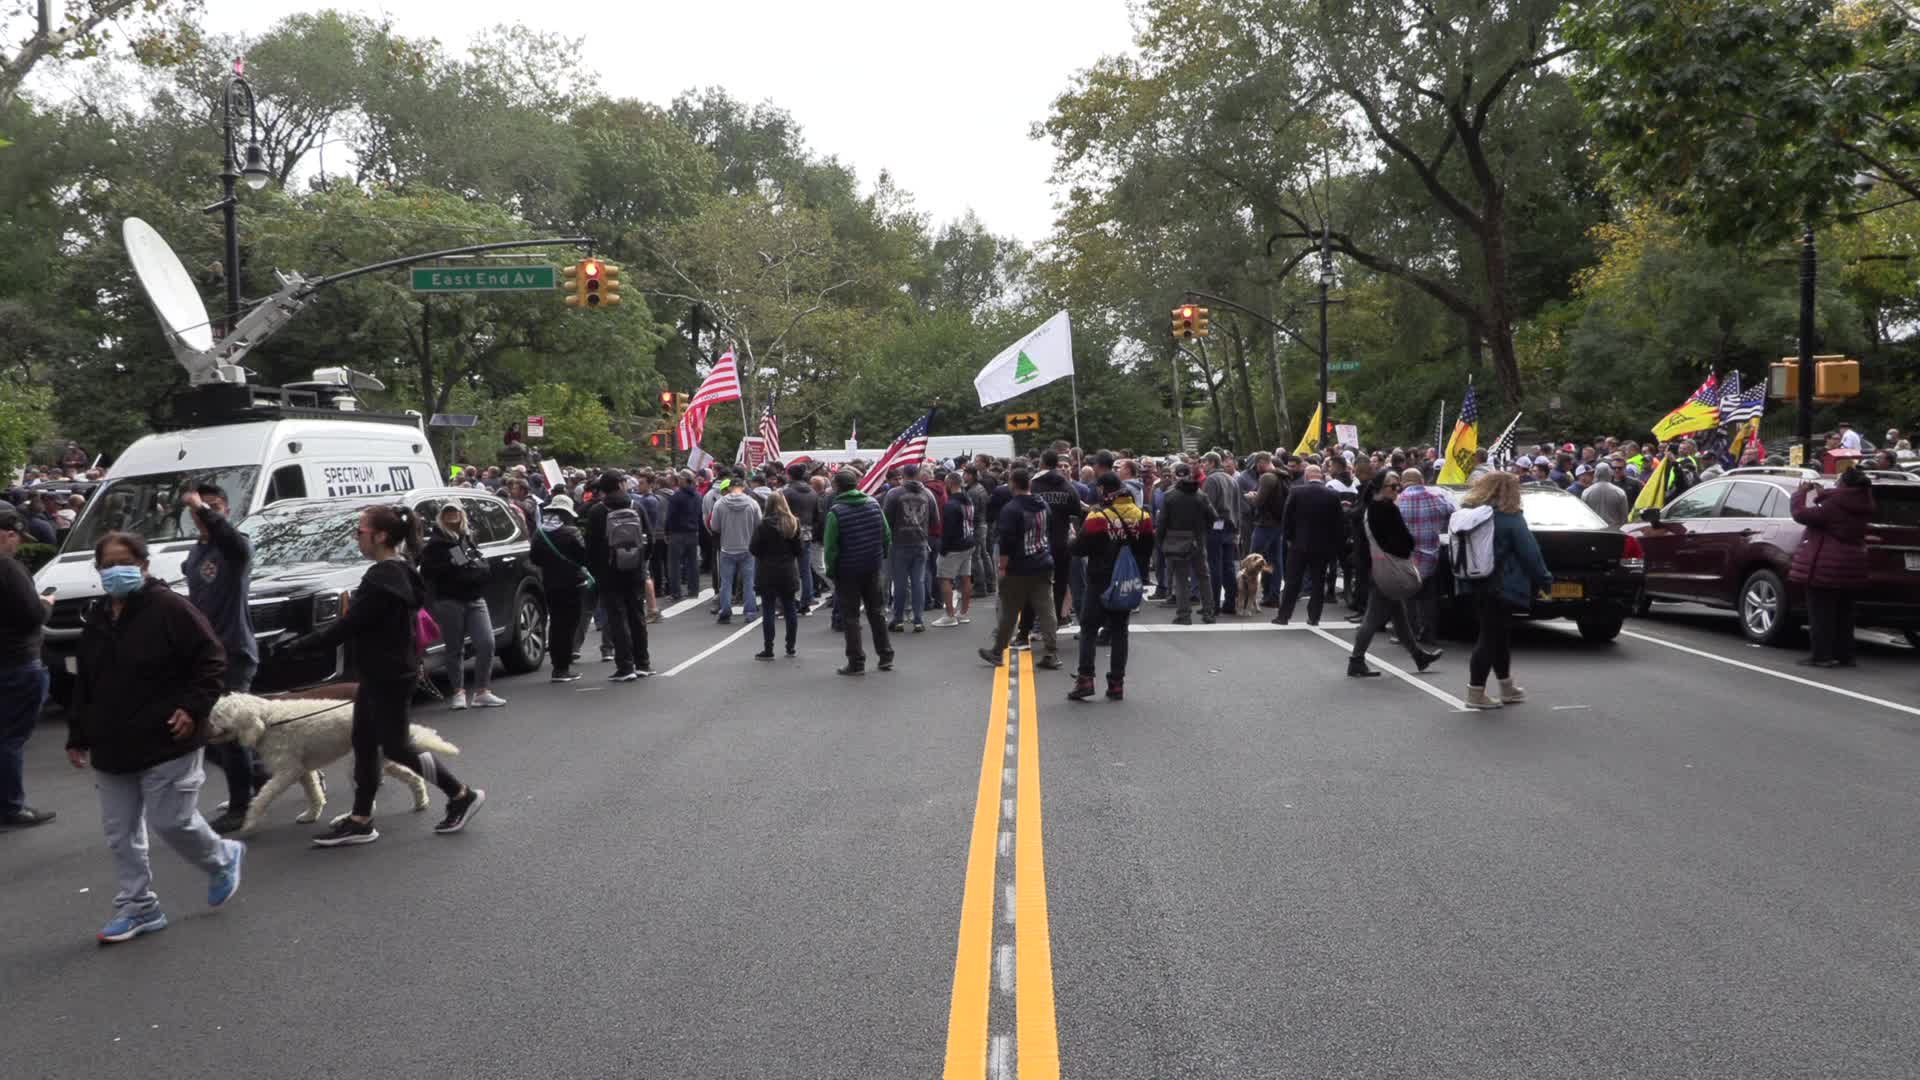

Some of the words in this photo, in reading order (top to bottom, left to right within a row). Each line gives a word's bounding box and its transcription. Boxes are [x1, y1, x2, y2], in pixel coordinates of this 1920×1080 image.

[431, 273, 471, 286] East
[476, 272, 508, 285] End
[513, 271, 536, 285] Av
[324, 466, 375, 484] SPECTRUM
[391, 468, 412, 491] NY
